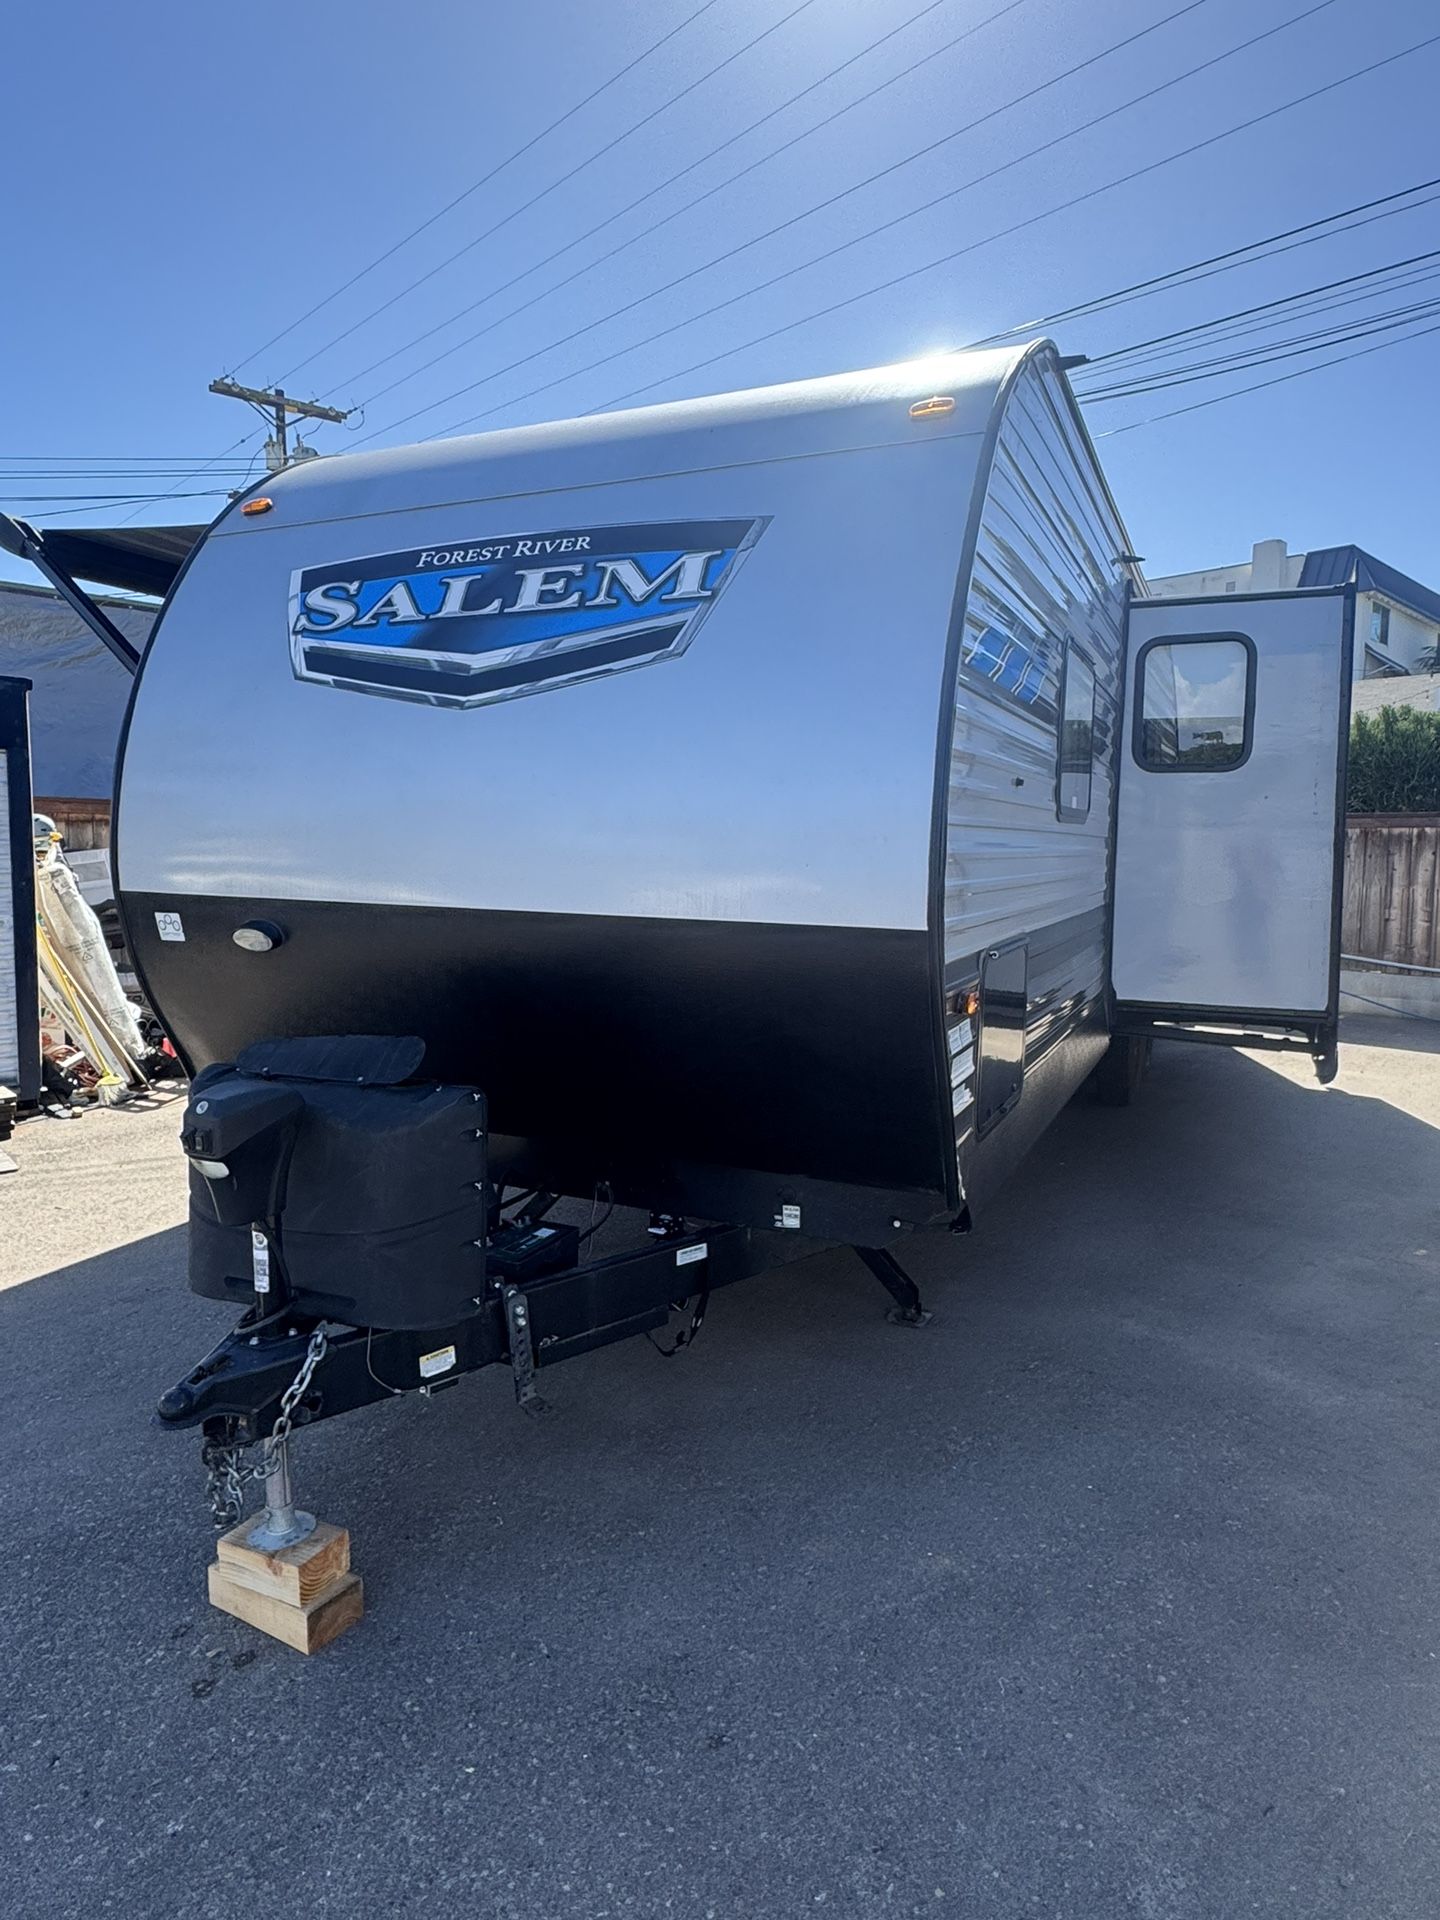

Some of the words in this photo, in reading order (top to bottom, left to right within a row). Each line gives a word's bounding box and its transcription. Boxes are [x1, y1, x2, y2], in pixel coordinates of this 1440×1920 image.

[416, 548, 510, 568] FOREST
[513, 537, 591, 557] RIVER
[295, 549, 721, 632] SALEM
